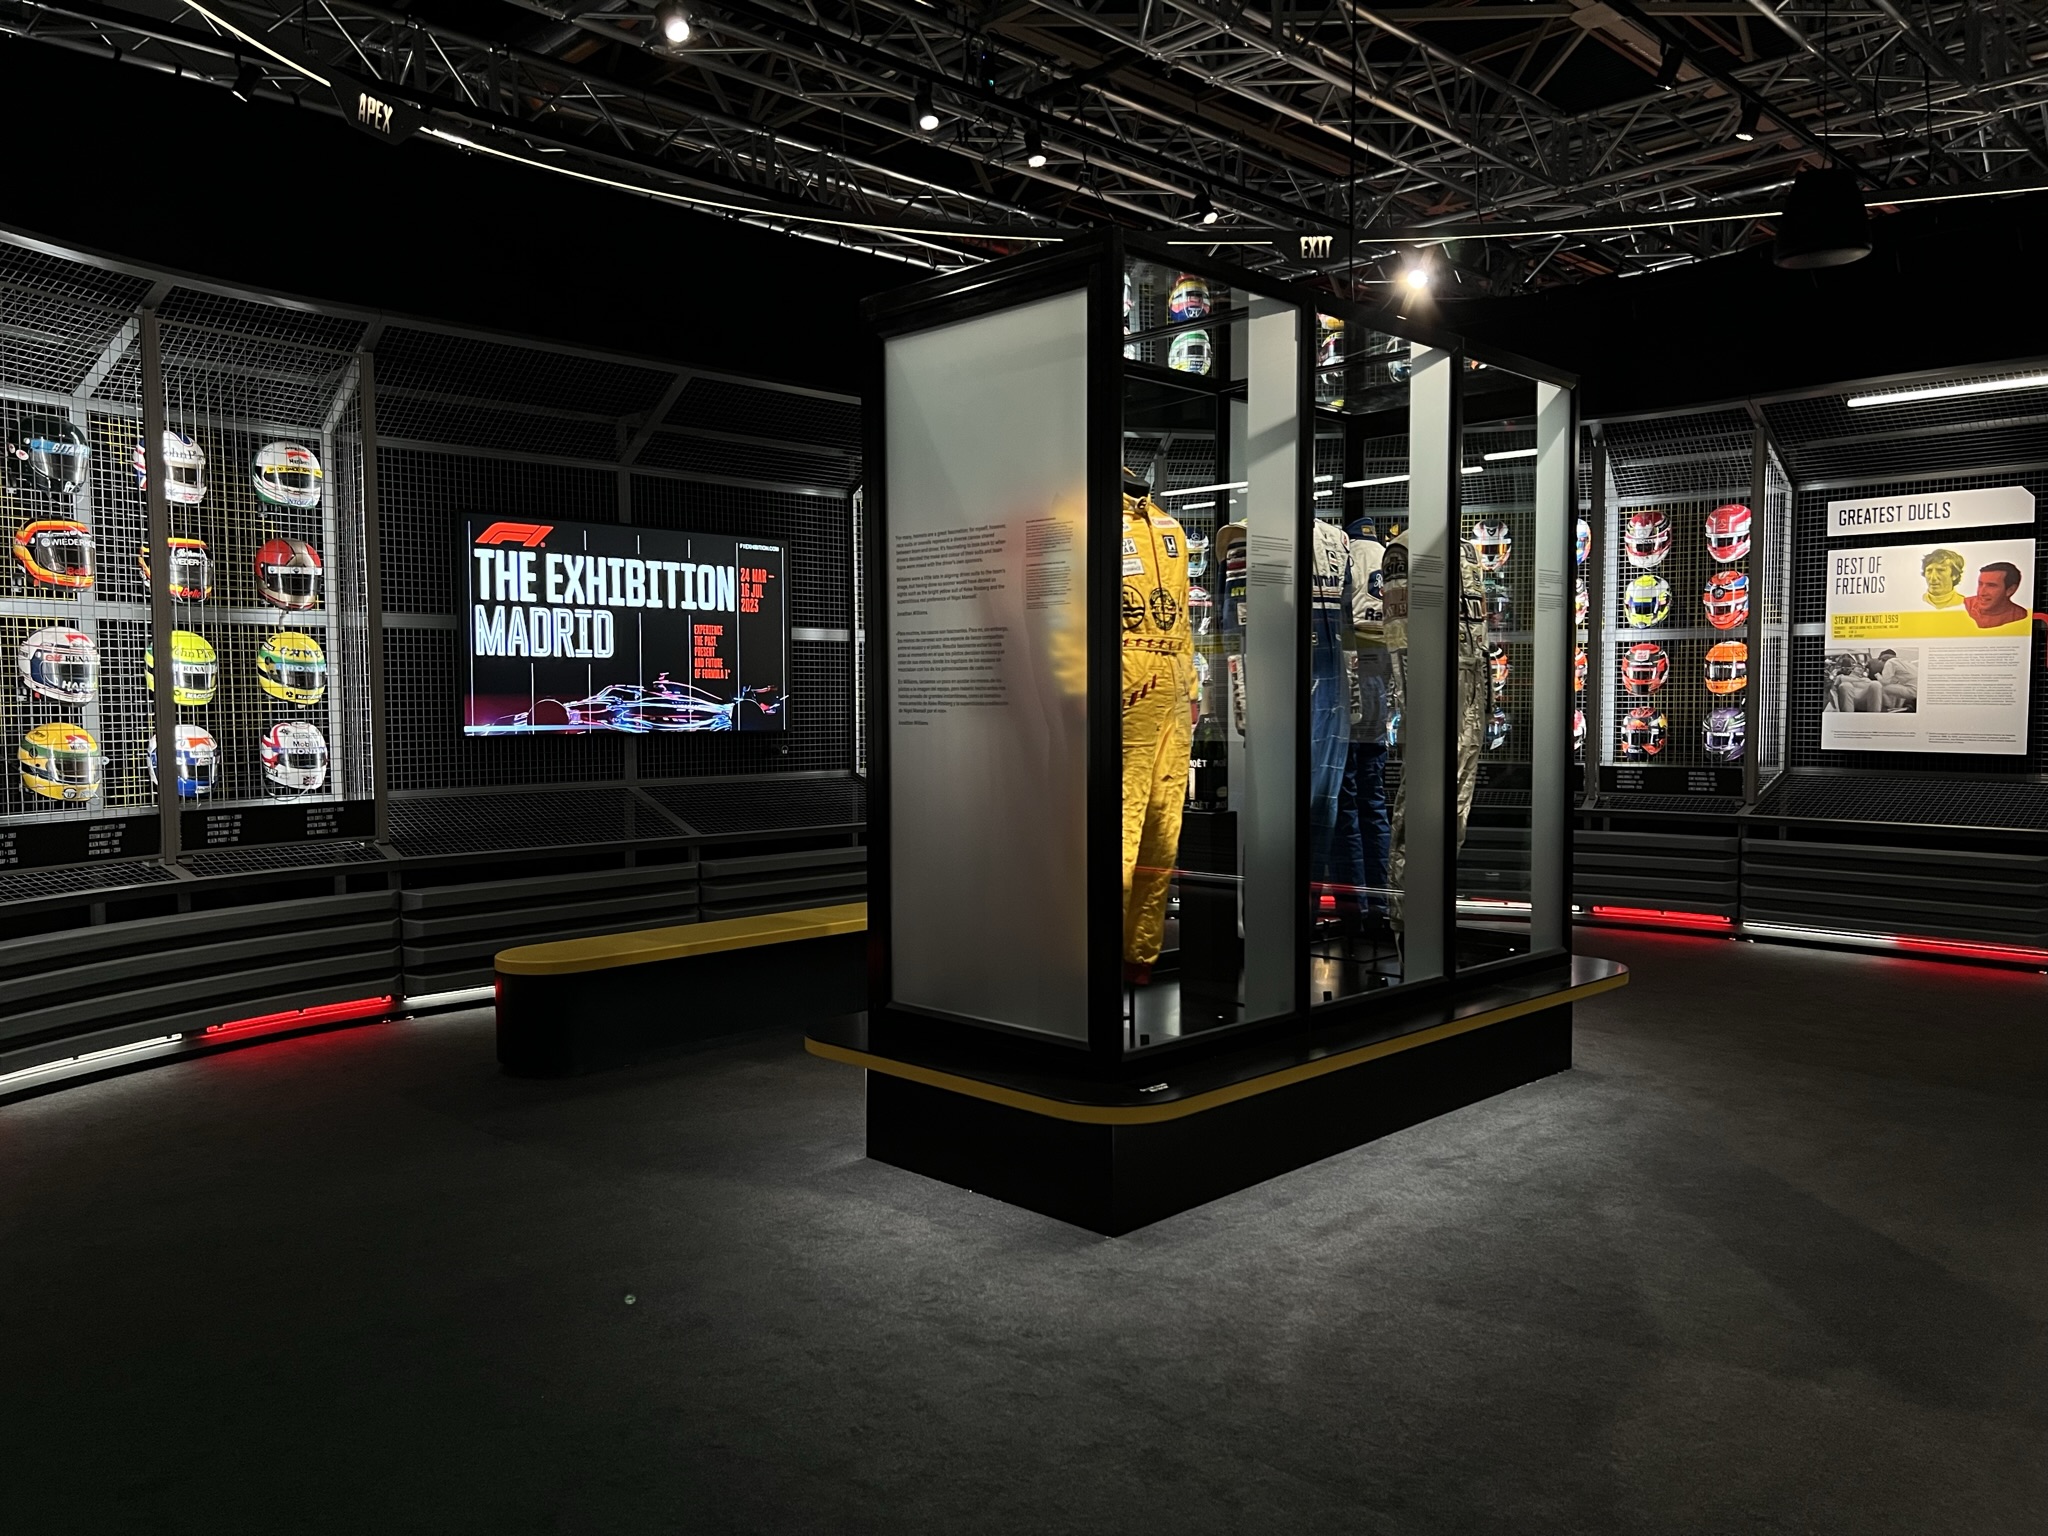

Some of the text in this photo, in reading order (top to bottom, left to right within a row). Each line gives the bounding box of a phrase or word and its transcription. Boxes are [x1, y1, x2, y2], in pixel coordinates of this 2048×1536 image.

[358, 92, 394, 134] APEX
[1300, 236, 1333, 258] EXIT
[1838, 501, 1951, 526] GREATEST DUELS
[1836, 556, 1883, 576] BEST OF
[474, 548, 736, 612] THE EXHIBITION
[740, 568, 750, 582] 24
[752, 568, 767, 583] MAR
[740, 583, 764, 598] 16 JUL
[1836, 575, 1886, 596] FRIENDS
[740, 598, 759, 613] 2023
[1834, 616, 1858, 625] STEWART
[1884, 614, 1899, 623] 1969
[474, 605, 614, 658] MADRID
[694, 624, 723, 635] EXPERIENCE
[694, 636, 704, 646] THE
[694, 646, 715, 657] PRESENT
[694, 658, 723, 668] AND FUTURE
[695, 669, 701, 679] OF
[702, 669, 724, 679] FORMULA
